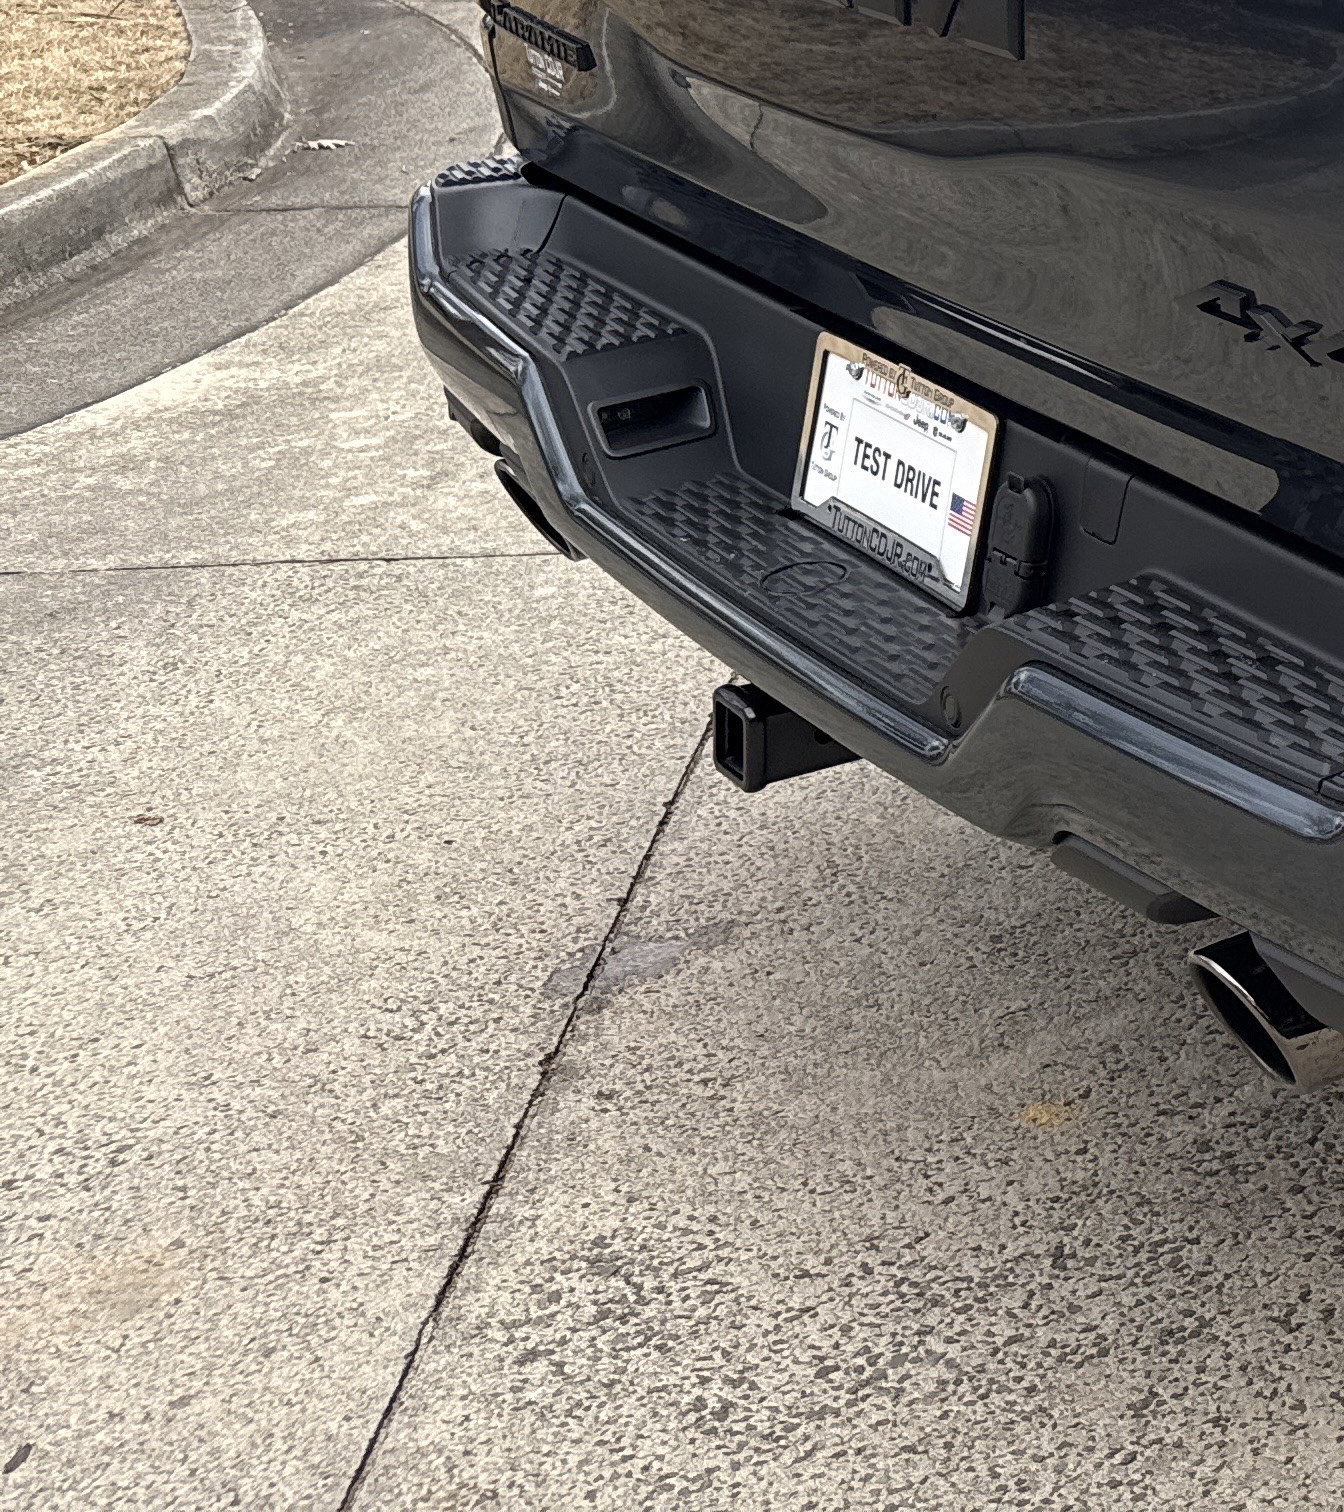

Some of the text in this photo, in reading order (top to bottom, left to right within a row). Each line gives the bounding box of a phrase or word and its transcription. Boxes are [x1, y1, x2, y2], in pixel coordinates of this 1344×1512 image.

[492, 0, 582, 71] LARAMIE
[854, 436, 941, 510] TEST DRIVE
